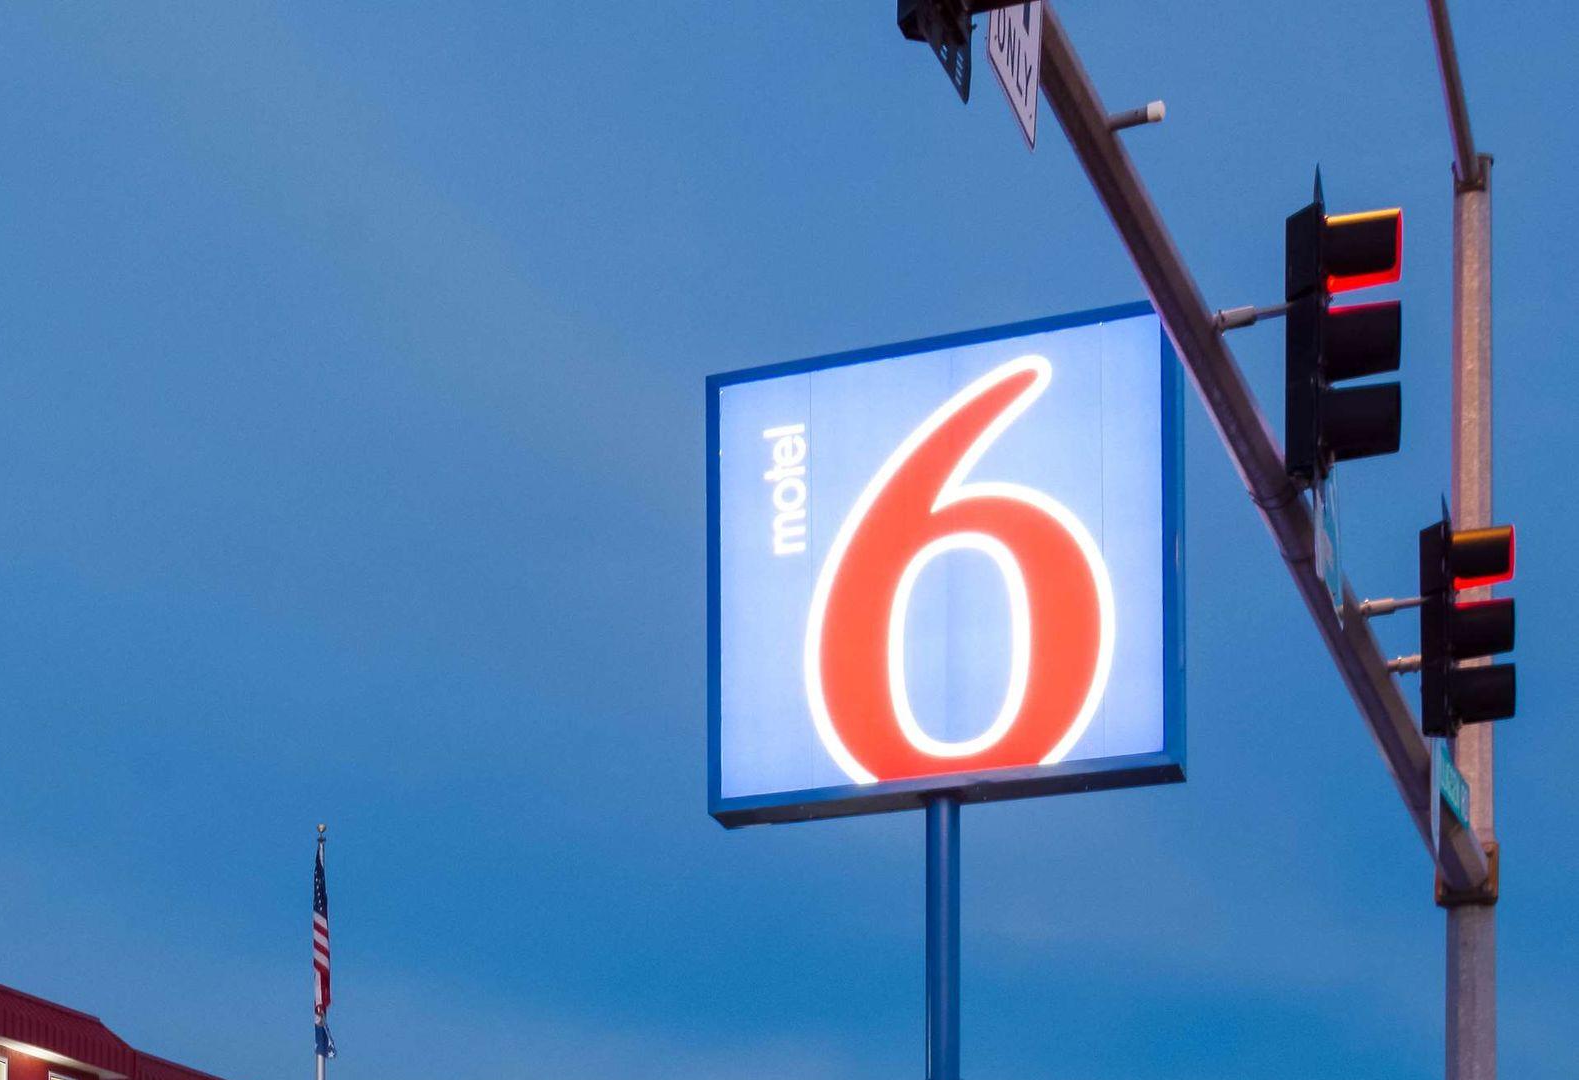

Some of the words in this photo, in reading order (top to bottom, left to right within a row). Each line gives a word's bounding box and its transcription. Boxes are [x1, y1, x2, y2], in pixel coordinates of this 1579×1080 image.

[997, 8, 1032, 106] ONLY
[763, 423, 807, 555] motel
[804, 355, 1115, 784] 6
